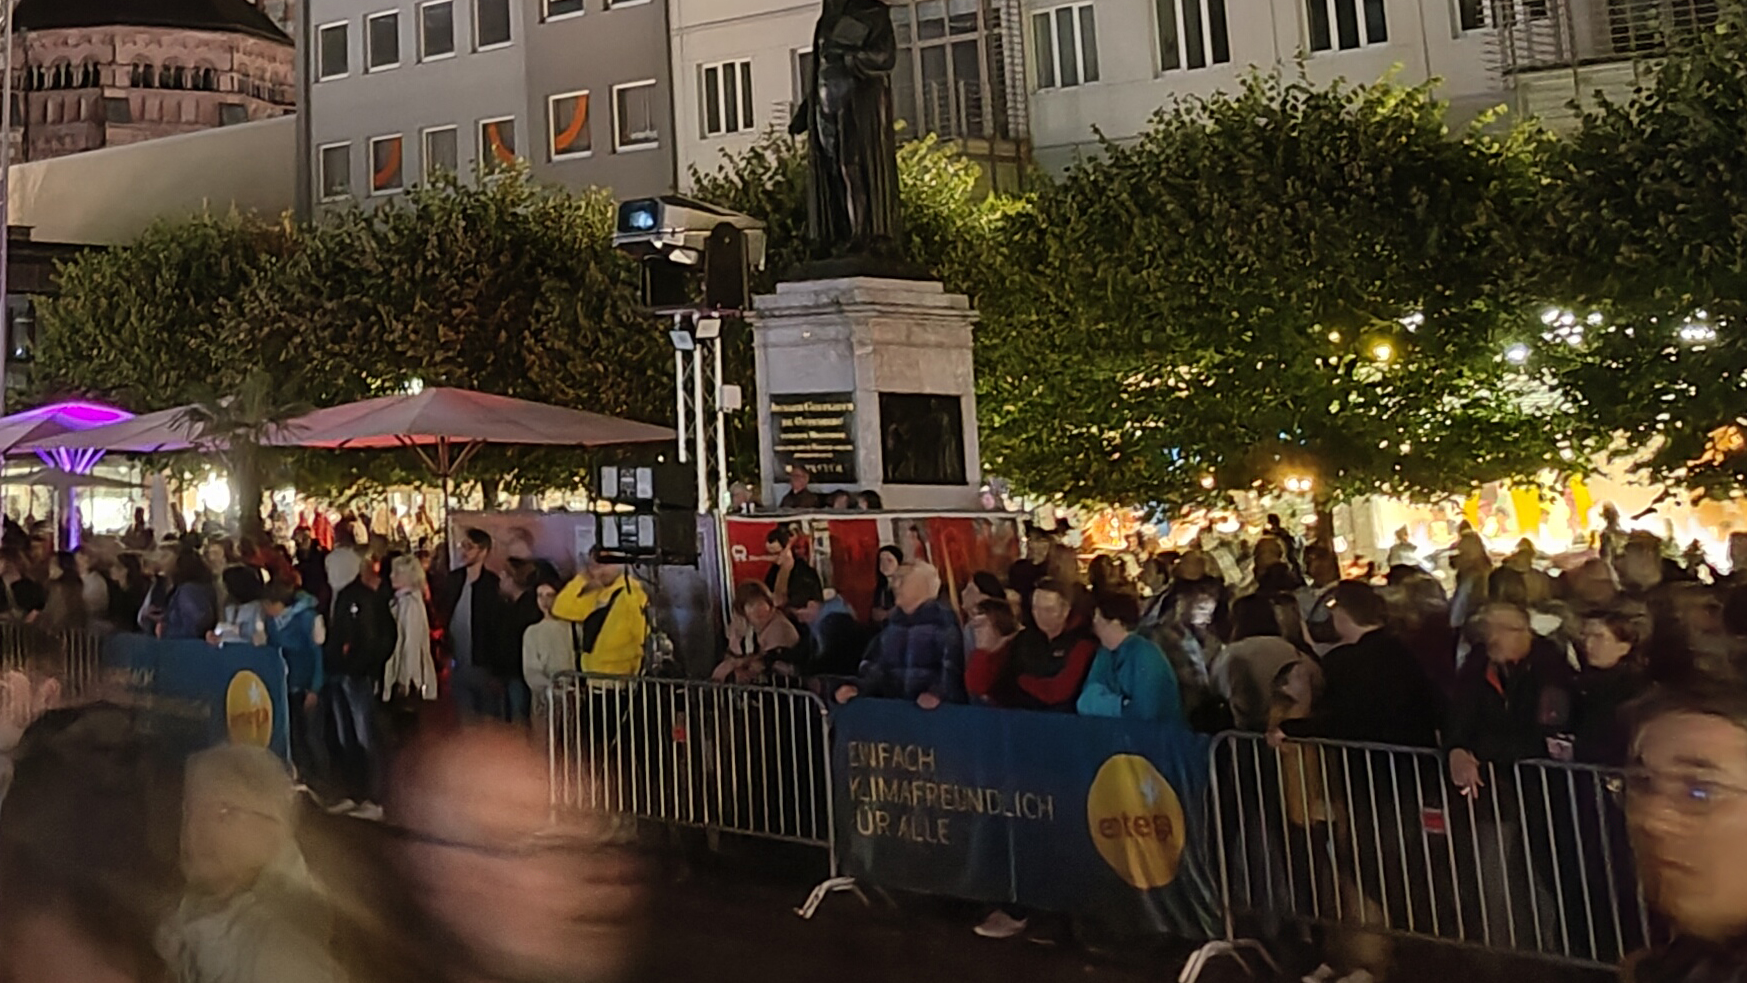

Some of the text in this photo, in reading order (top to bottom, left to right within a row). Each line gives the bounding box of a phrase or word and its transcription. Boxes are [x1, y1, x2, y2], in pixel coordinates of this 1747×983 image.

[848, 741, 936, 773] EINFACH
[854, 803, 951, 846] ÜR ALLE
